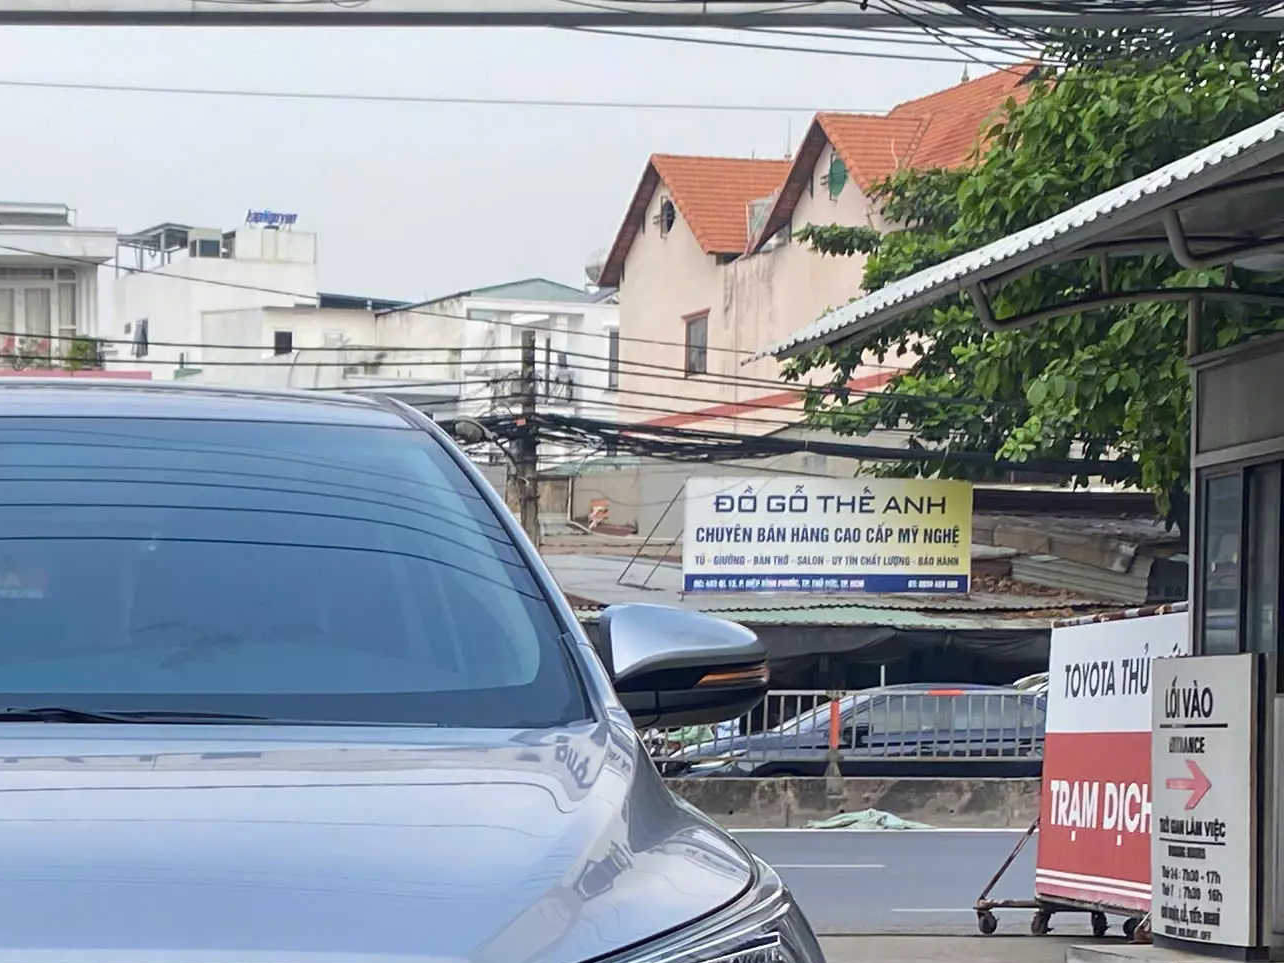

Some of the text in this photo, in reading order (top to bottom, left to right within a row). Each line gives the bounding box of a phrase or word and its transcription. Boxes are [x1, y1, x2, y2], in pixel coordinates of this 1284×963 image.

[713, 484, 947, 514] ĐỒ GỖ THẾ ANH
[696, 521, 960, 548] CHUYÊN BÁN HÀNG CAO CẤP MỸ NGHỆ
[797, 555, 824, 566] SALON
[1065, 642, 1151, 698] TOYOTA THỦ
[1182, 680, 1213, 718] VÀO
[1050, 780, 1099, 842] TRẠM
